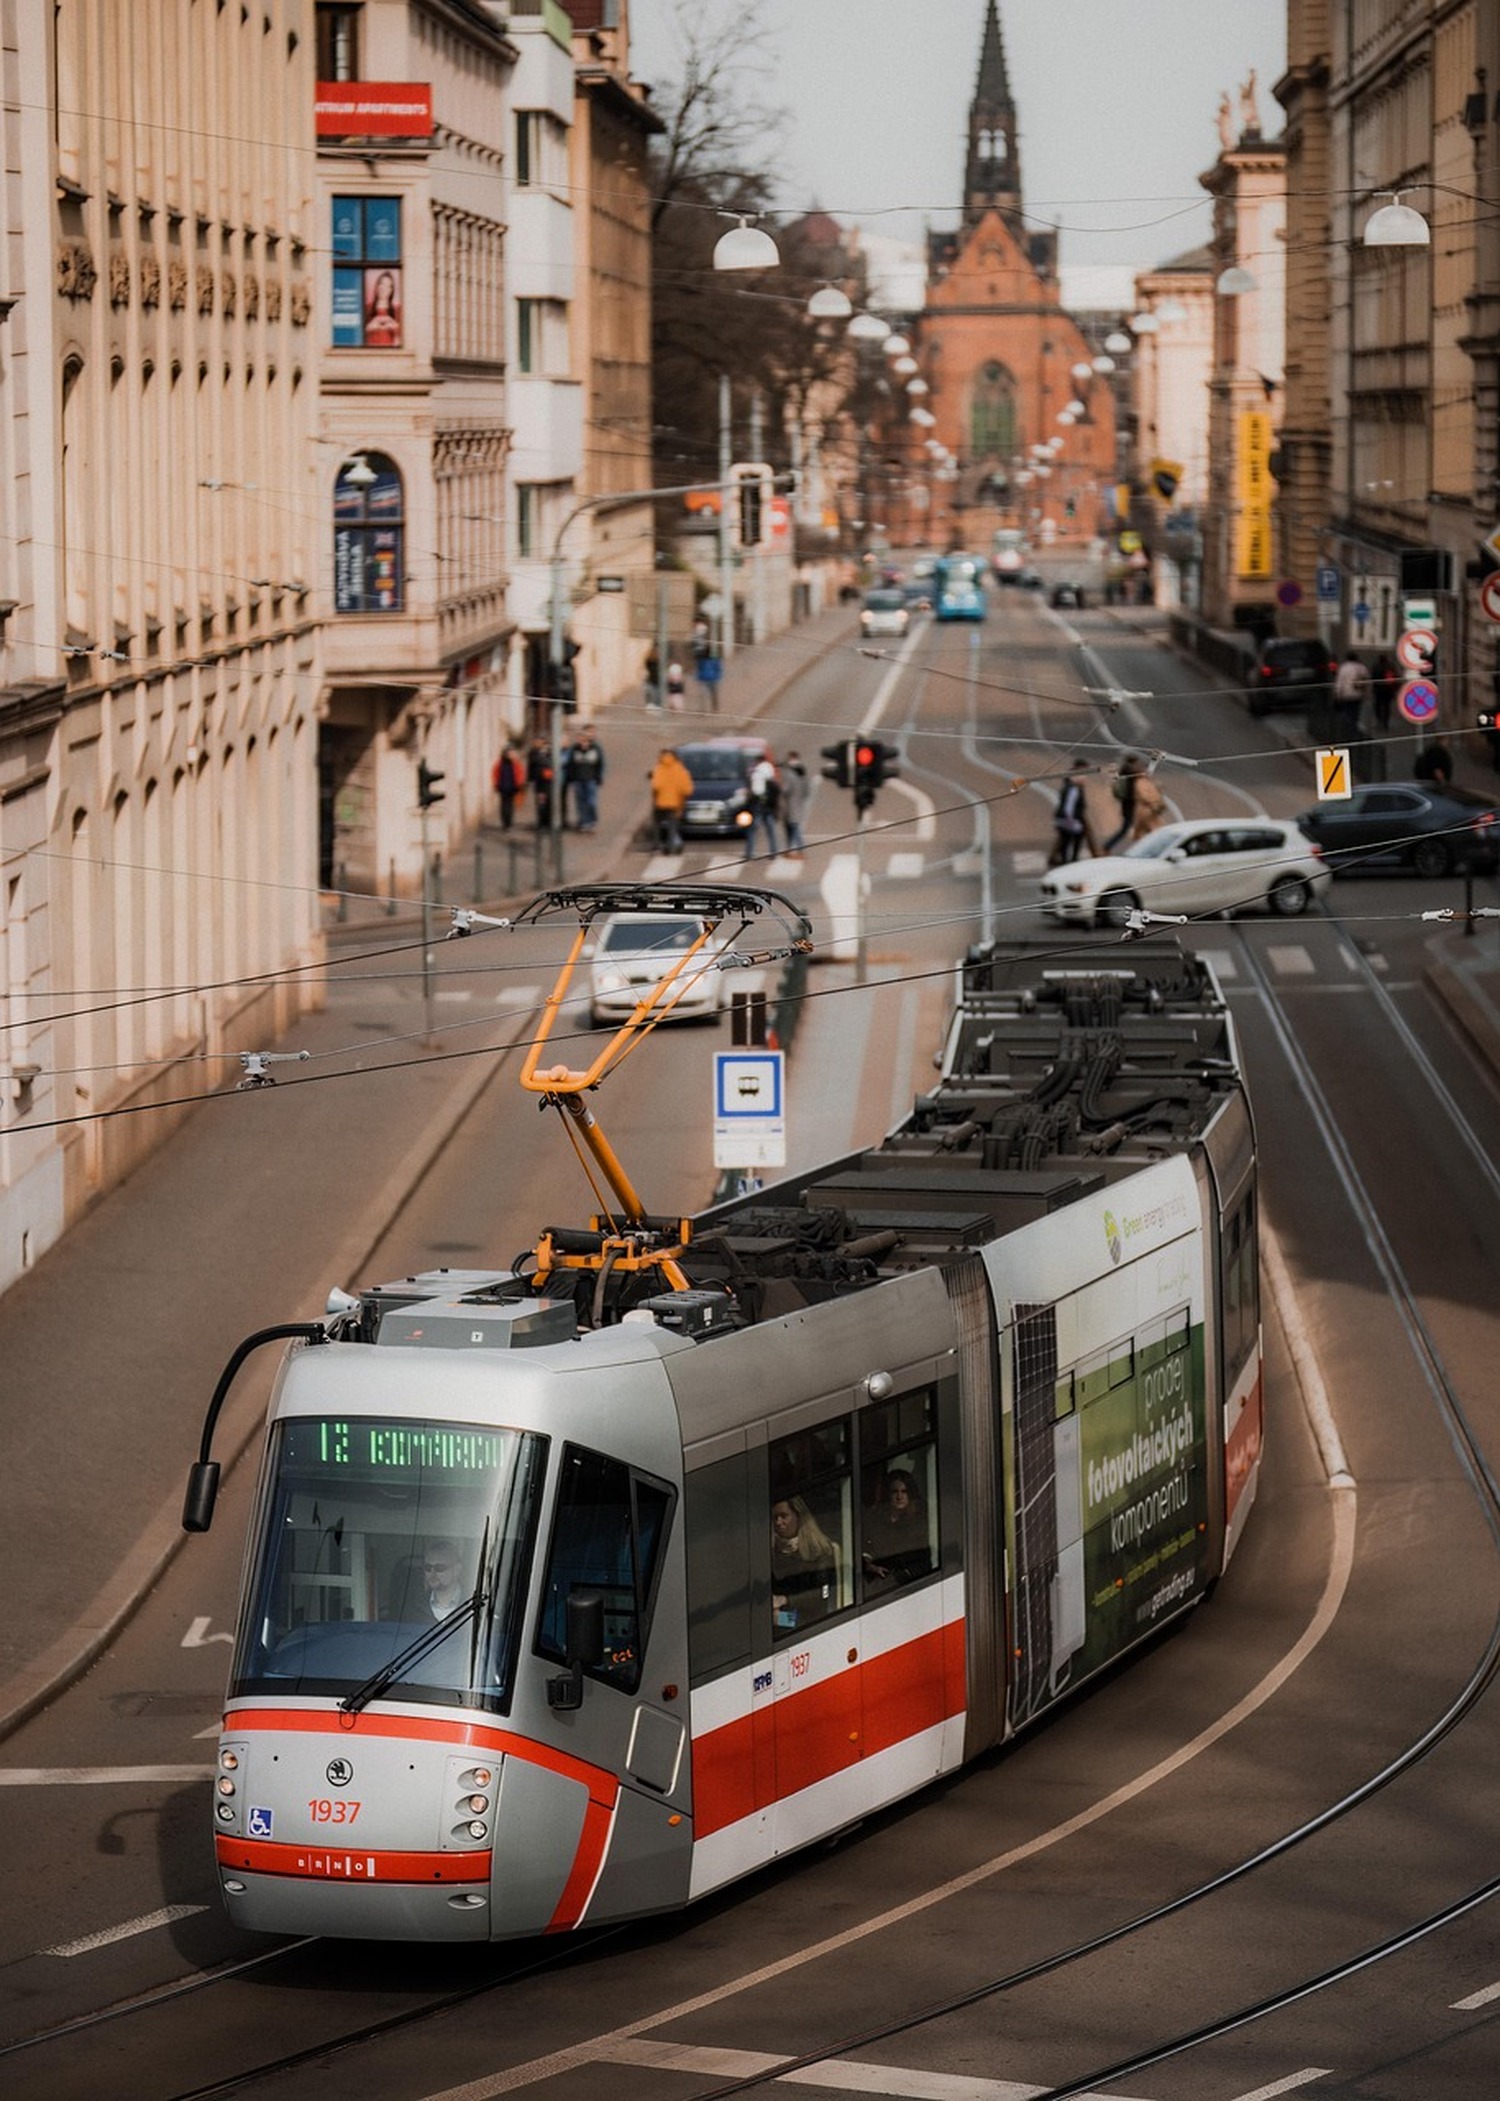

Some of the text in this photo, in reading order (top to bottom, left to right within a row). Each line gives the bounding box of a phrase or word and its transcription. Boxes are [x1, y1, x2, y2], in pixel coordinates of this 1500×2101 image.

[1144, 1344, 1185, 1421] prodej
[1087, 1401, 1194, 1507] fotovoltaických
[1110, 1458, 1189, 1554] komponentů
[790, 1652, 811, 1679] 1937
[308, 1798, 362, 1824] 1937
[297, 1857, 366, 1873] BRNO
